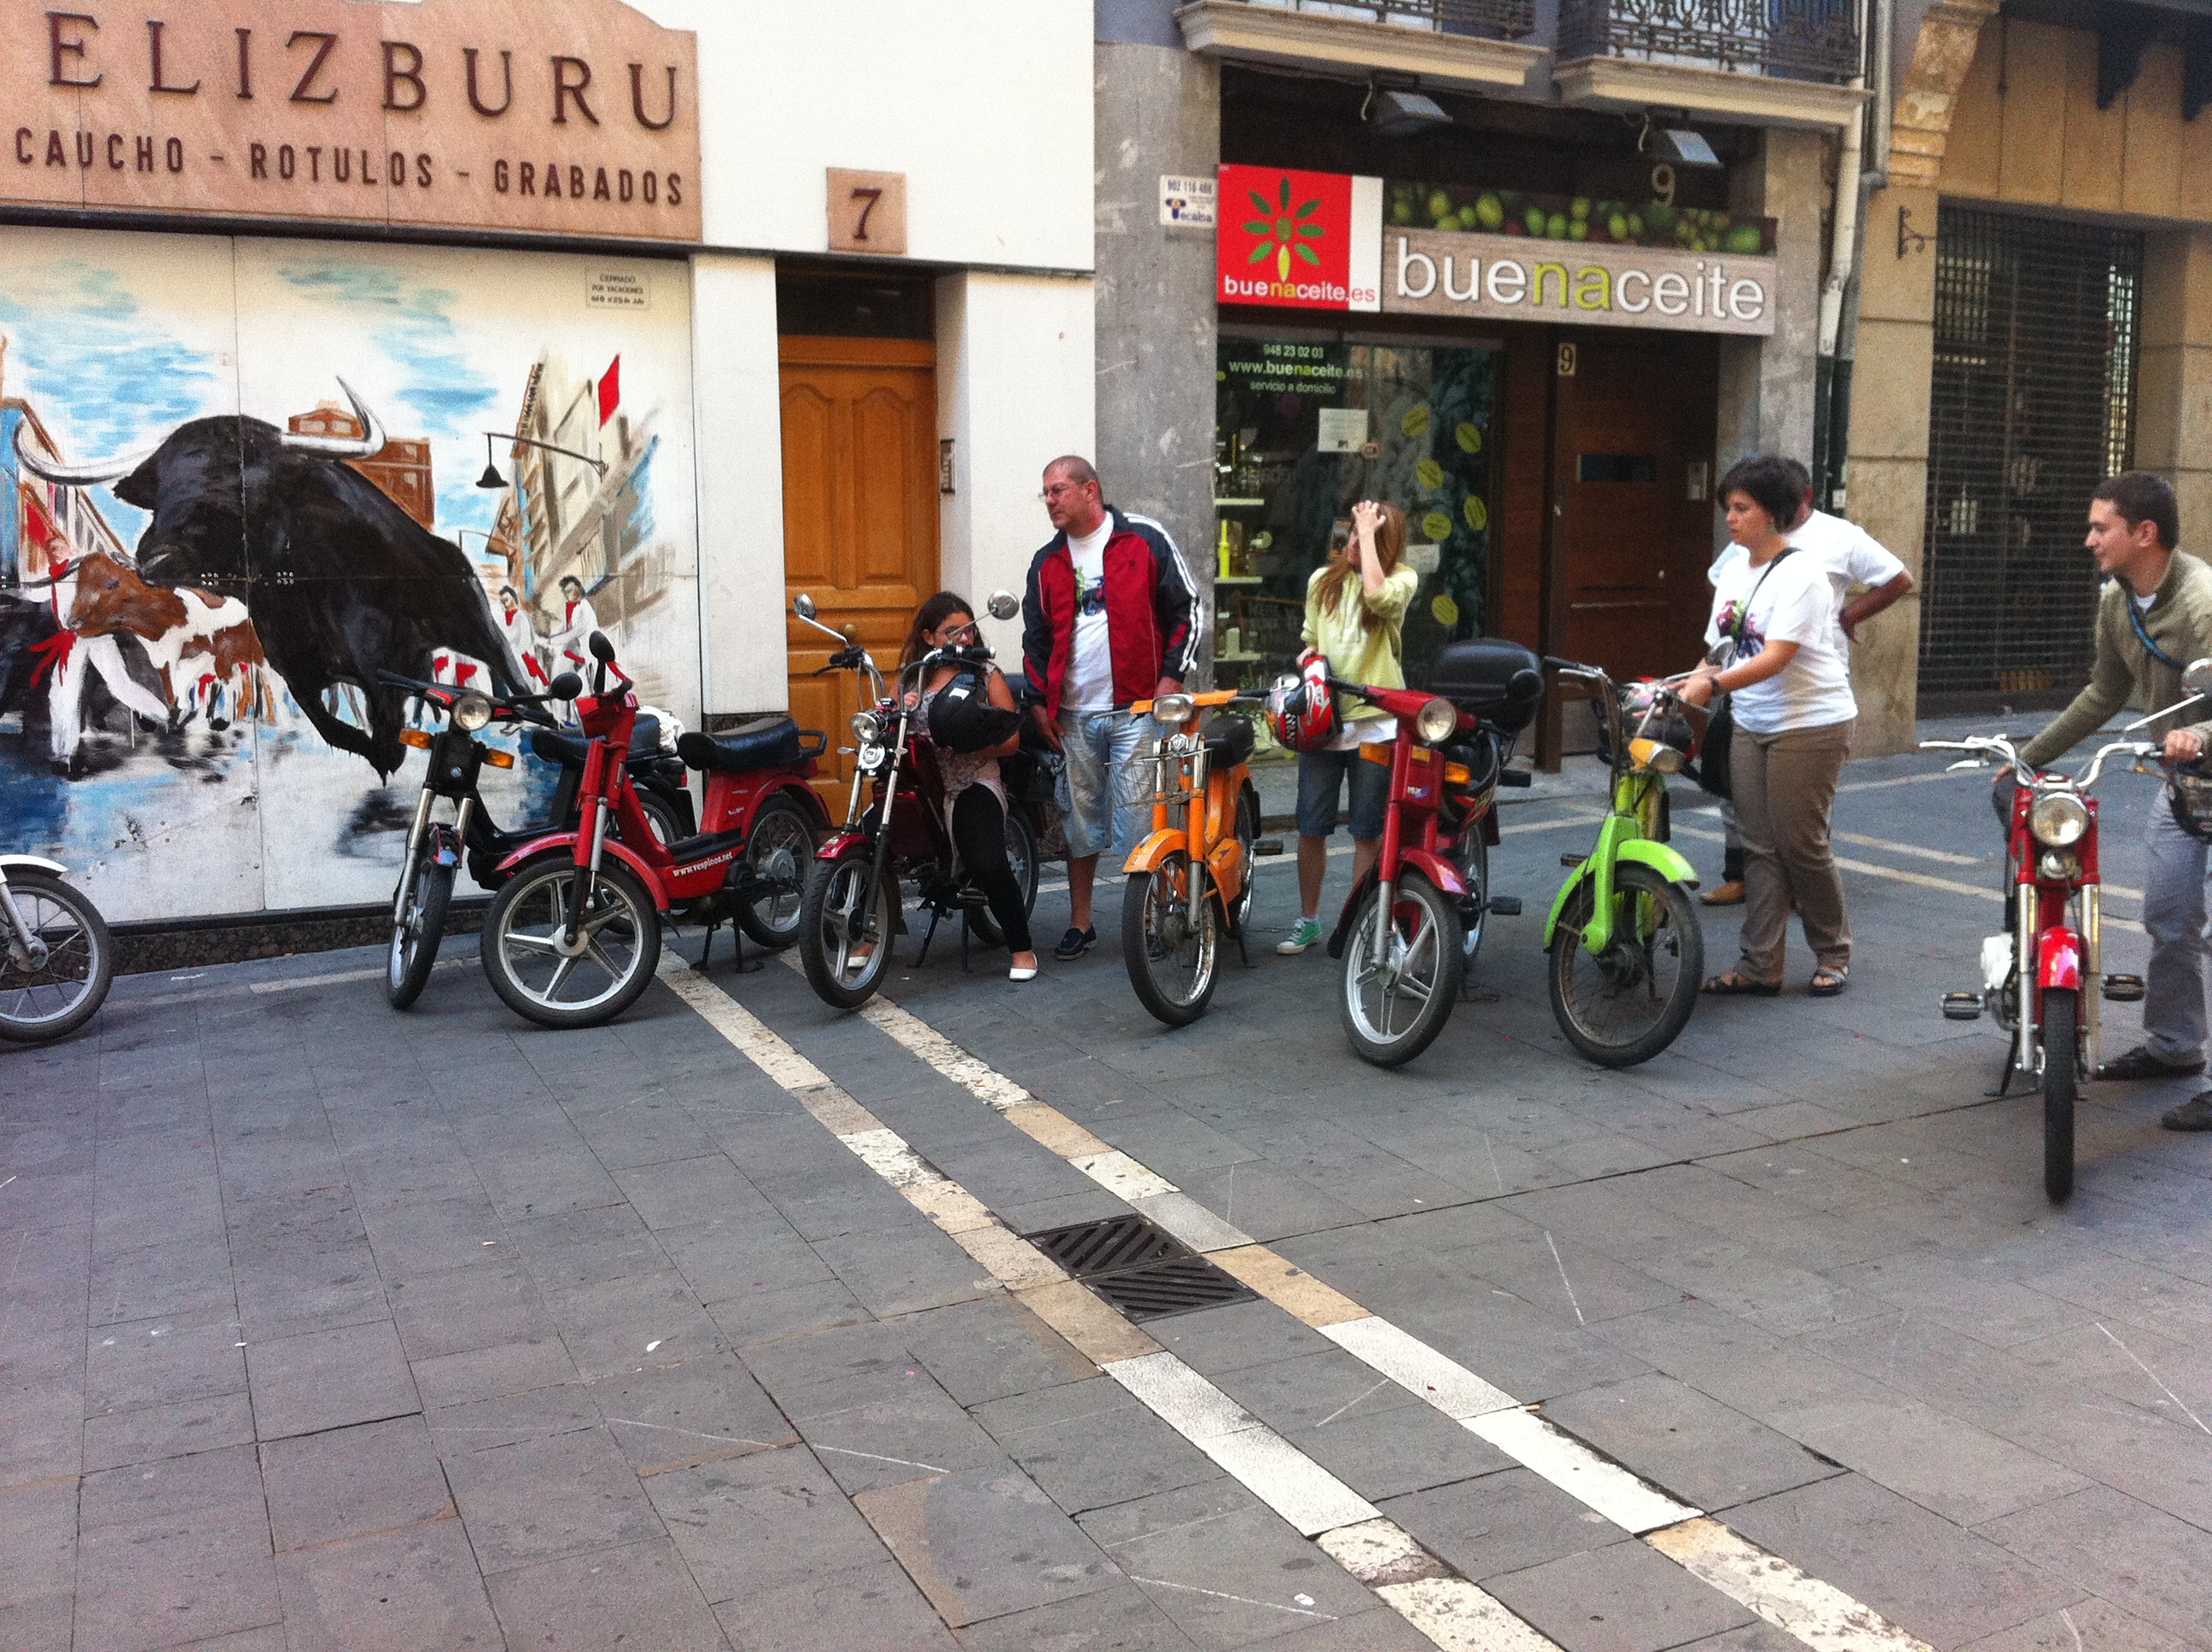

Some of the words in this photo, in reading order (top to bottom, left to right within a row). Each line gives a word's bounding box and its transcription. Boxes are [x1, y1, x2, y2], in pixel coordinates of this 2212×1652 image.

[44, 10, 678, 130] ELIZBURU
[15, 126, 184, 172] CAUCHO
[249, 142, 434, 189] ROTULOS
[493, 158, 683, 206] GRABADOS
[1650, 163, 1675, 206] 9
[850, 188, 882, 240] 7
[1224, 273, 1377, 303] buenaceite.es
[1397, 235, 1765, 321] buenaceite
[1228, 359, 1364, 380] www.buenaceite.es
[1284, 345, 1295, 358] 23
[1297, 346, 1309, 358] 02
[1561, 346, 1573, 373] 9
[1249, 380, 1286, 393] servicio
[1295, 381, 1336, 394] domicilio
